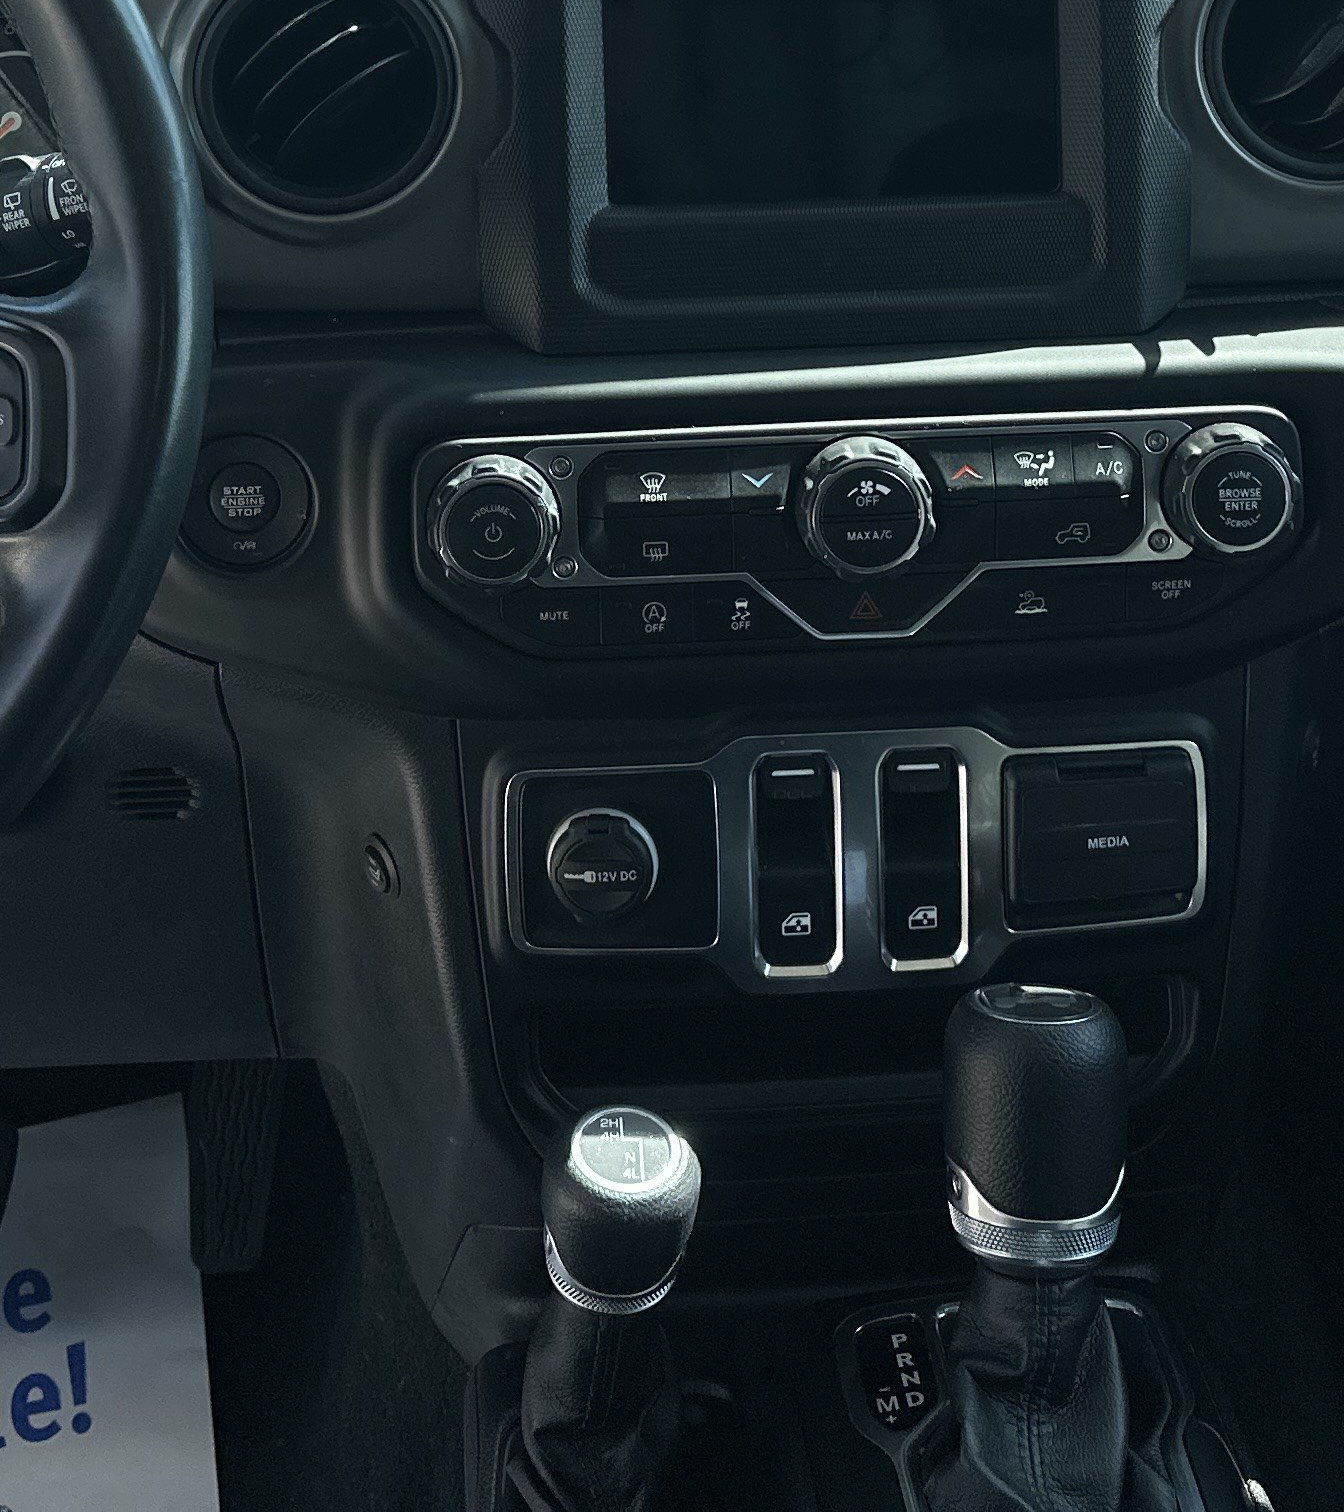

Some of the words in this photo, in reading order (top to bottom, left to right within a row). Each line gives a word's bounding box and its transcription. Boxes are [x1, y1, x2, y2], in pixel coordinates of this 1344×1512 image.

[59, 194, 85, 208] FRON
[3, 209, 25, 222] REAR
[62, 203, 90, 217] WIPE
[2, 218, 32, 232] WIPER
[1095, 459, 1125, 476] A/C
[1228, 470, 1253, 481] TUNE
[1024, 477, 1050, 488] MODE
[223, 486, 262, 495] START
[1218, 487, 1262, 500] BROWSE
[221, 497, 266, 506] ENGINE
[639, 492, 668, 503] FRONT
[855, 494, 881, 508] OFF
[228, 508, 262, 517] STOP
[474, 503, 512, 520] VOLUME
[1224, 500, 1259, 512] ENTER
[1223, 516, 1259, 529] SCROLL
[846, 530, 873, 542] MAX
[873, 528, 894, 541] A/C
[1151, 578, 1192, 591] SCREEN
[1160, 589, 1182, 600] OFF
[539, 610, 570, 622] MUTE
[644, 622, 665, 634] OFF
[731, 620, 752, 631] OFF
[1087, 834, 1131, 851] MEDIA
[595, 869, 619, 884] 12V
[620, 868, 639, 883] DC
[599, 1118, 619, 1128] 2H
[624, 1151, 636, 1166] N
[622, 1167, 640, 1179] 4L
[890, 1333, 908, 1349] P
[895, 1352, 915, 1368] R
[900, 1370, 921, 1387] N
[875, 1395, 901, 1413] M
[905, 1391, 925, 1408] D
